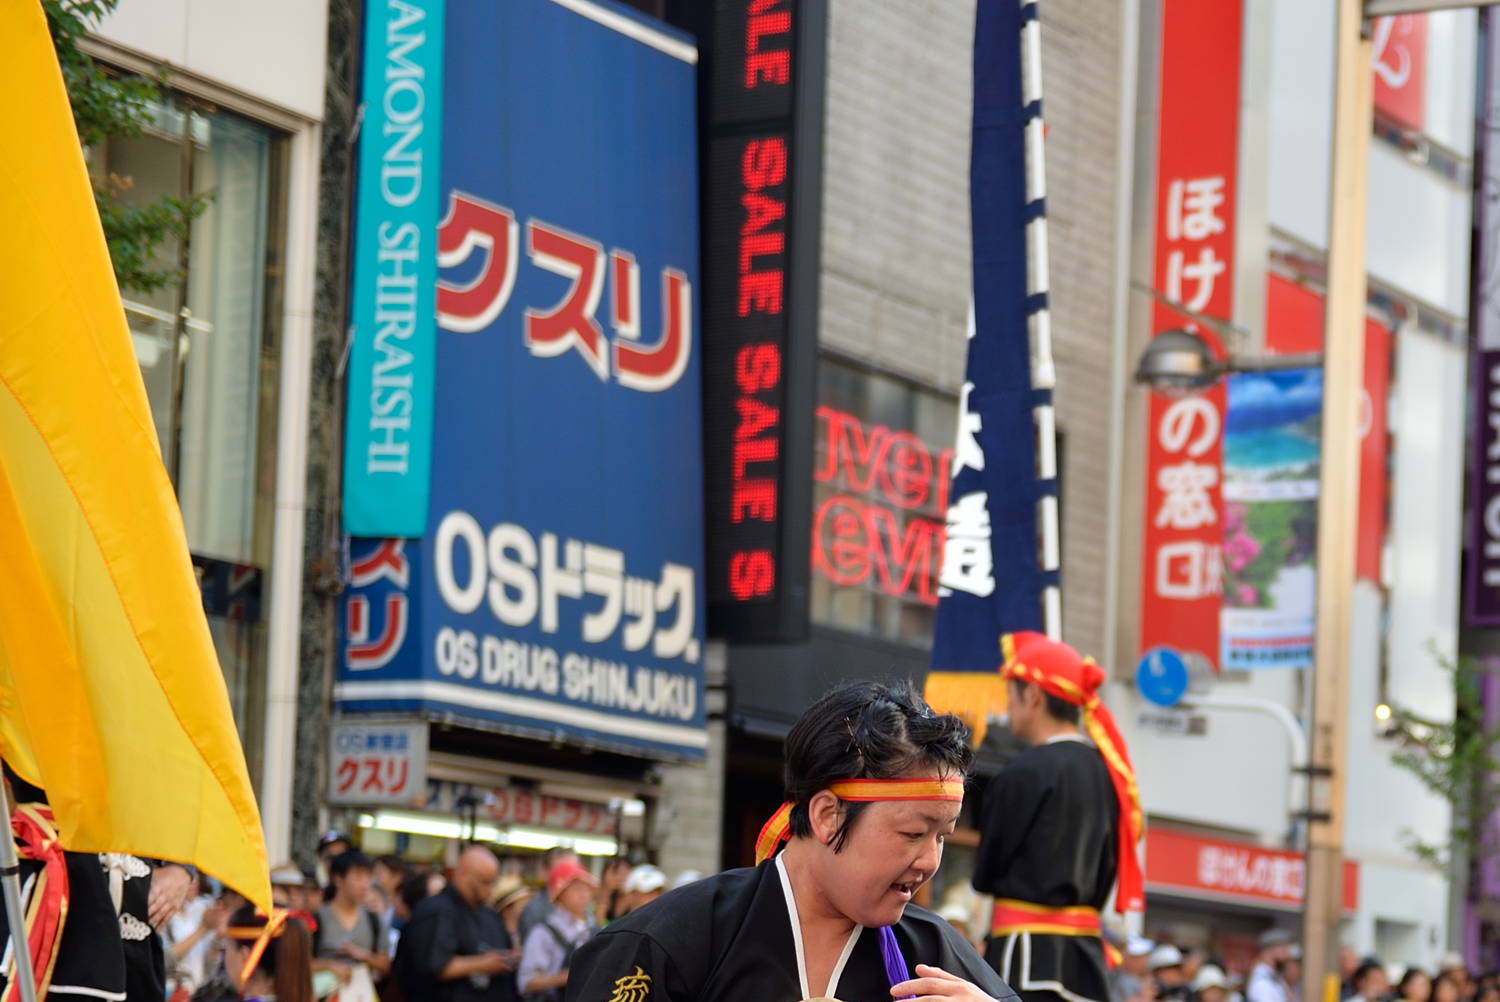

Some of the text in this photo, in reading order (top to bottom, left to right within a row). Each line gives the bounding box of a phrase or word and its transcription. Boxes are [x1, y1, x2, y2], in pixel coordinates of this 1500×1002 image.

[435, 189, 693, 393] クスリ
[736, 136, 788, 318] SALE
[367, 221, 420, 475] SHIRAISHI
[729, 343, 782, 524] SALE
[1155, 177, 1226, 599] ほけの窓口
[727, 550, 777, 601] S
[435, 625, 697, 722] OS DRUG SHINJUKU
[336, 756, 411, 796] クスリ
